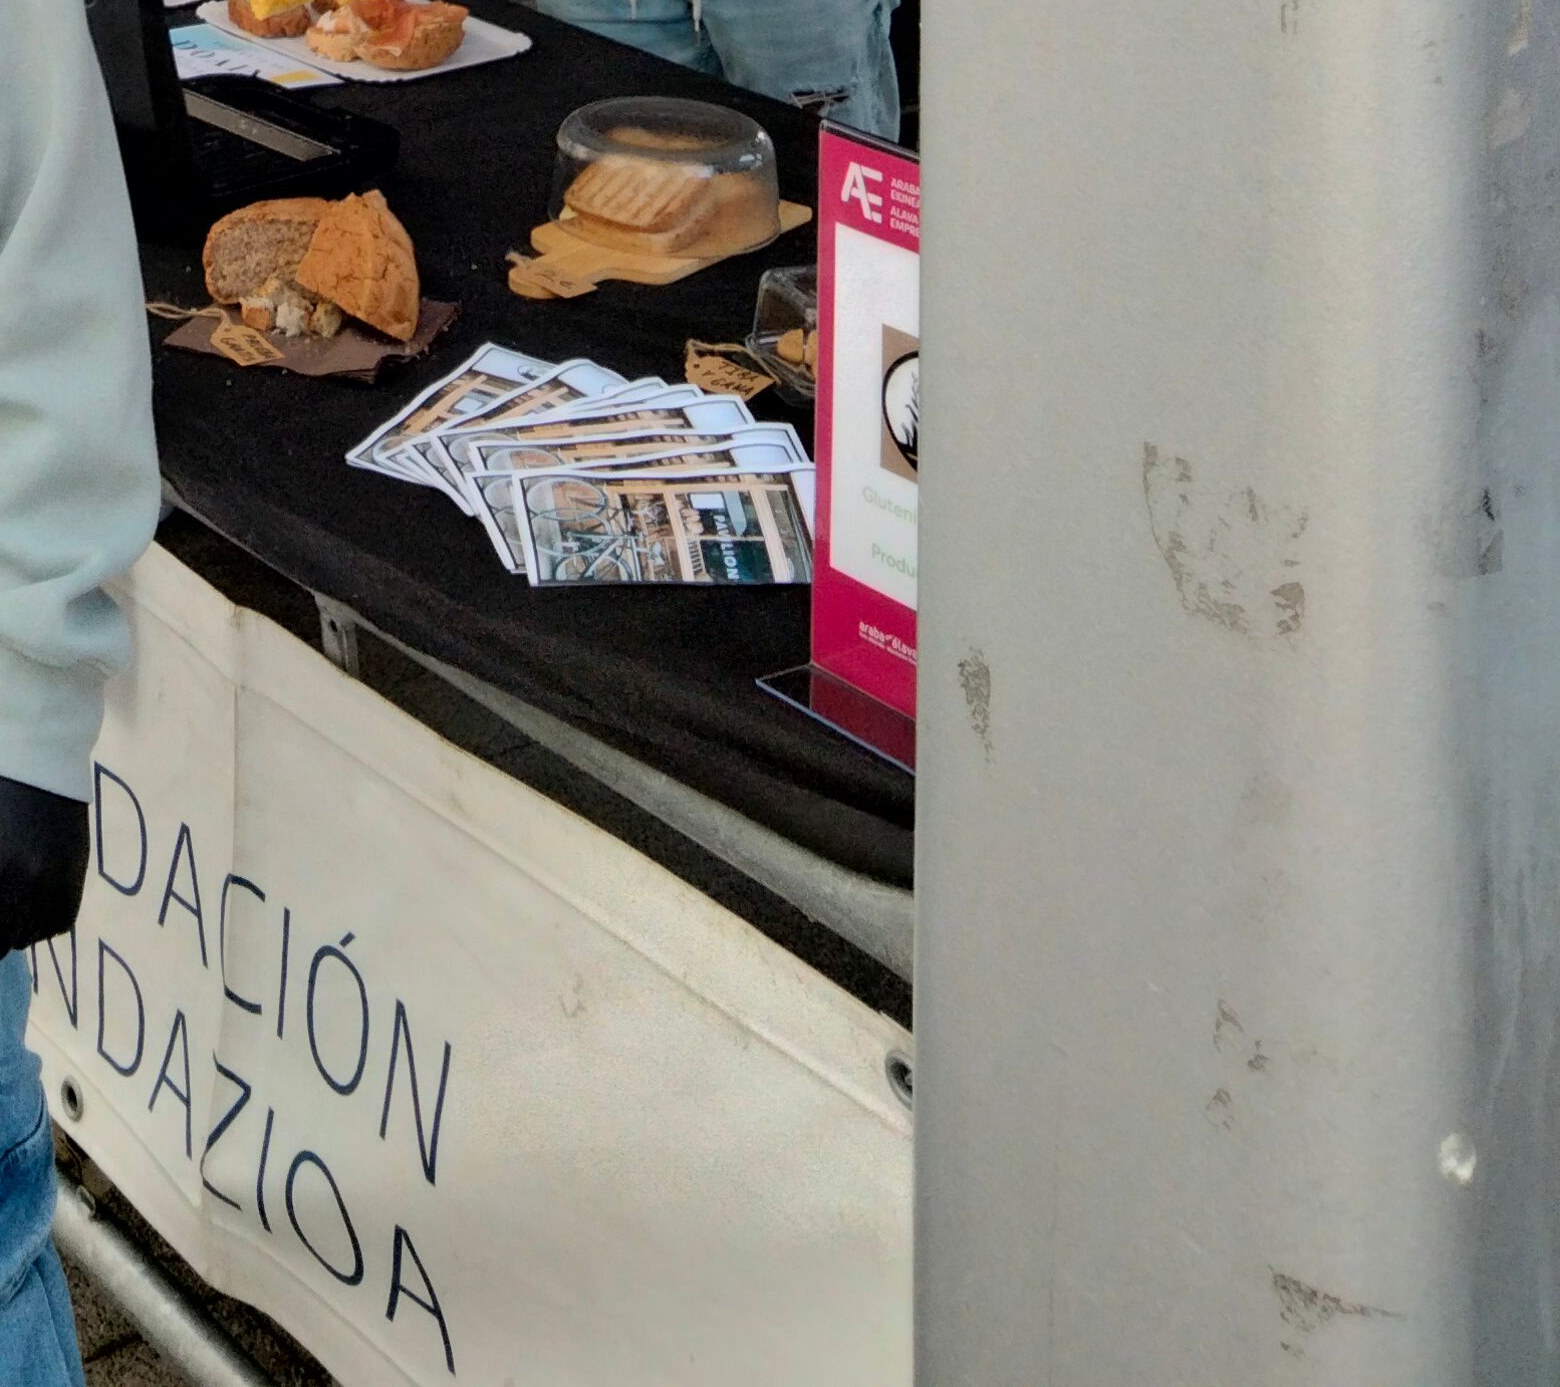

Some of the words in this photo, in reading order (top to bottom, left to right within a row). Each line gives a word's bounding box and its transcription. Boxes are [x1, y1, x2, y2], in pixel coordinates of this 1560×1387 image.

[890, 218, 920, 238] EMPRE
[862, 485, 918, 525] Gluteni
[871, 542, 918, 579] Produ
[94, 761, 453, 1186] DACIÓN
[31, 925, 457, 1376] NDAZIOA
